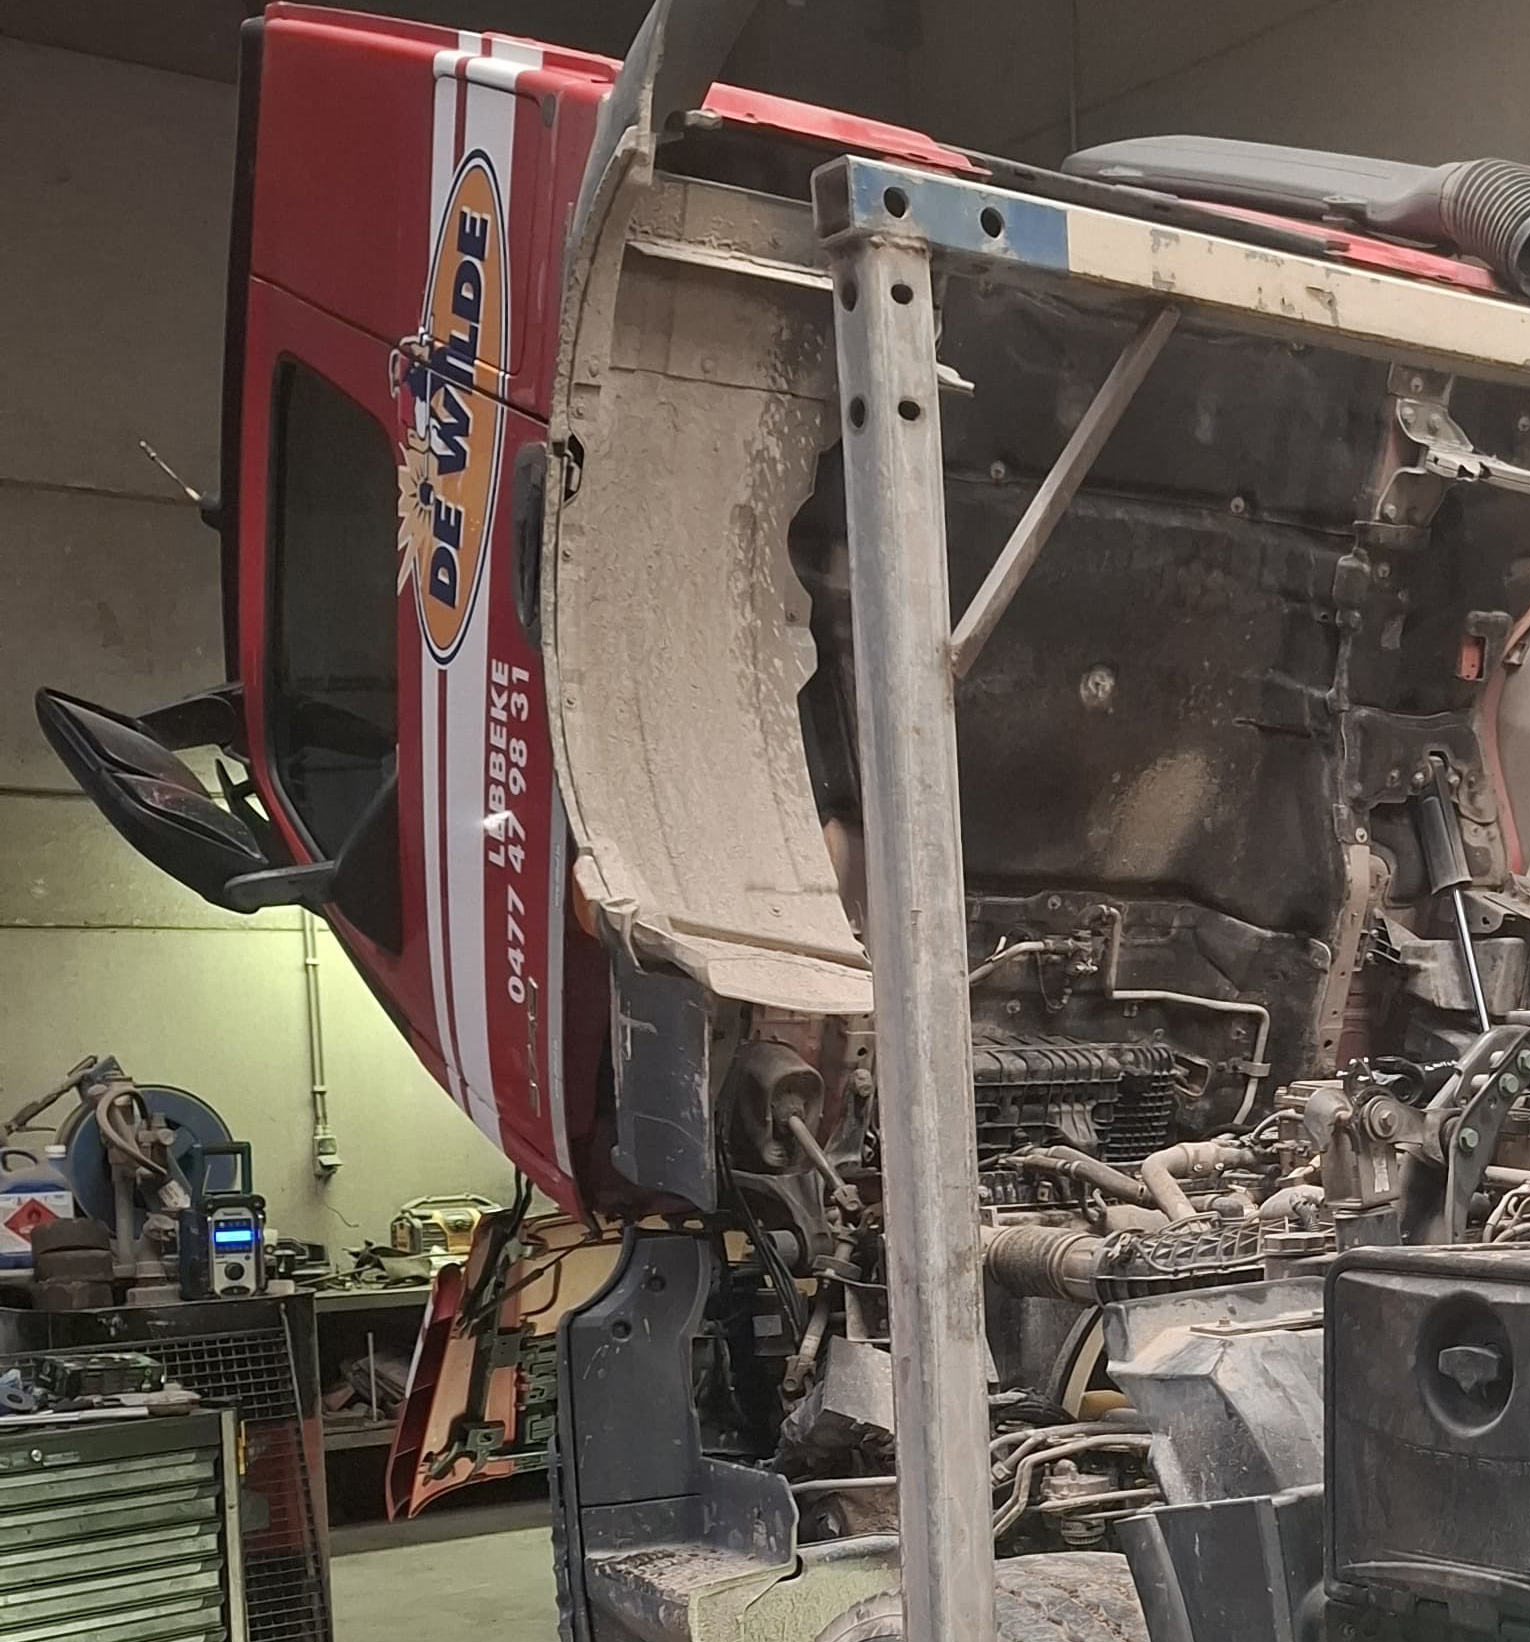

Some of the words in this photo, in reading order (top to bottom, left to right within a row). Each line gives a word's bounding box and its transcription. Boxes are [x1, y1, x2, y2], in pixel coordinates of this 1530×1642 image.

[428, 204, 491, 477] WILDE
[428, 495, 464, 609] DE
[510, 664, 531, 723] 31
[510, 736, 529, 797] 98
[509, 814, 527, 876] 47
[507, 883, 526, 1005] 0477
